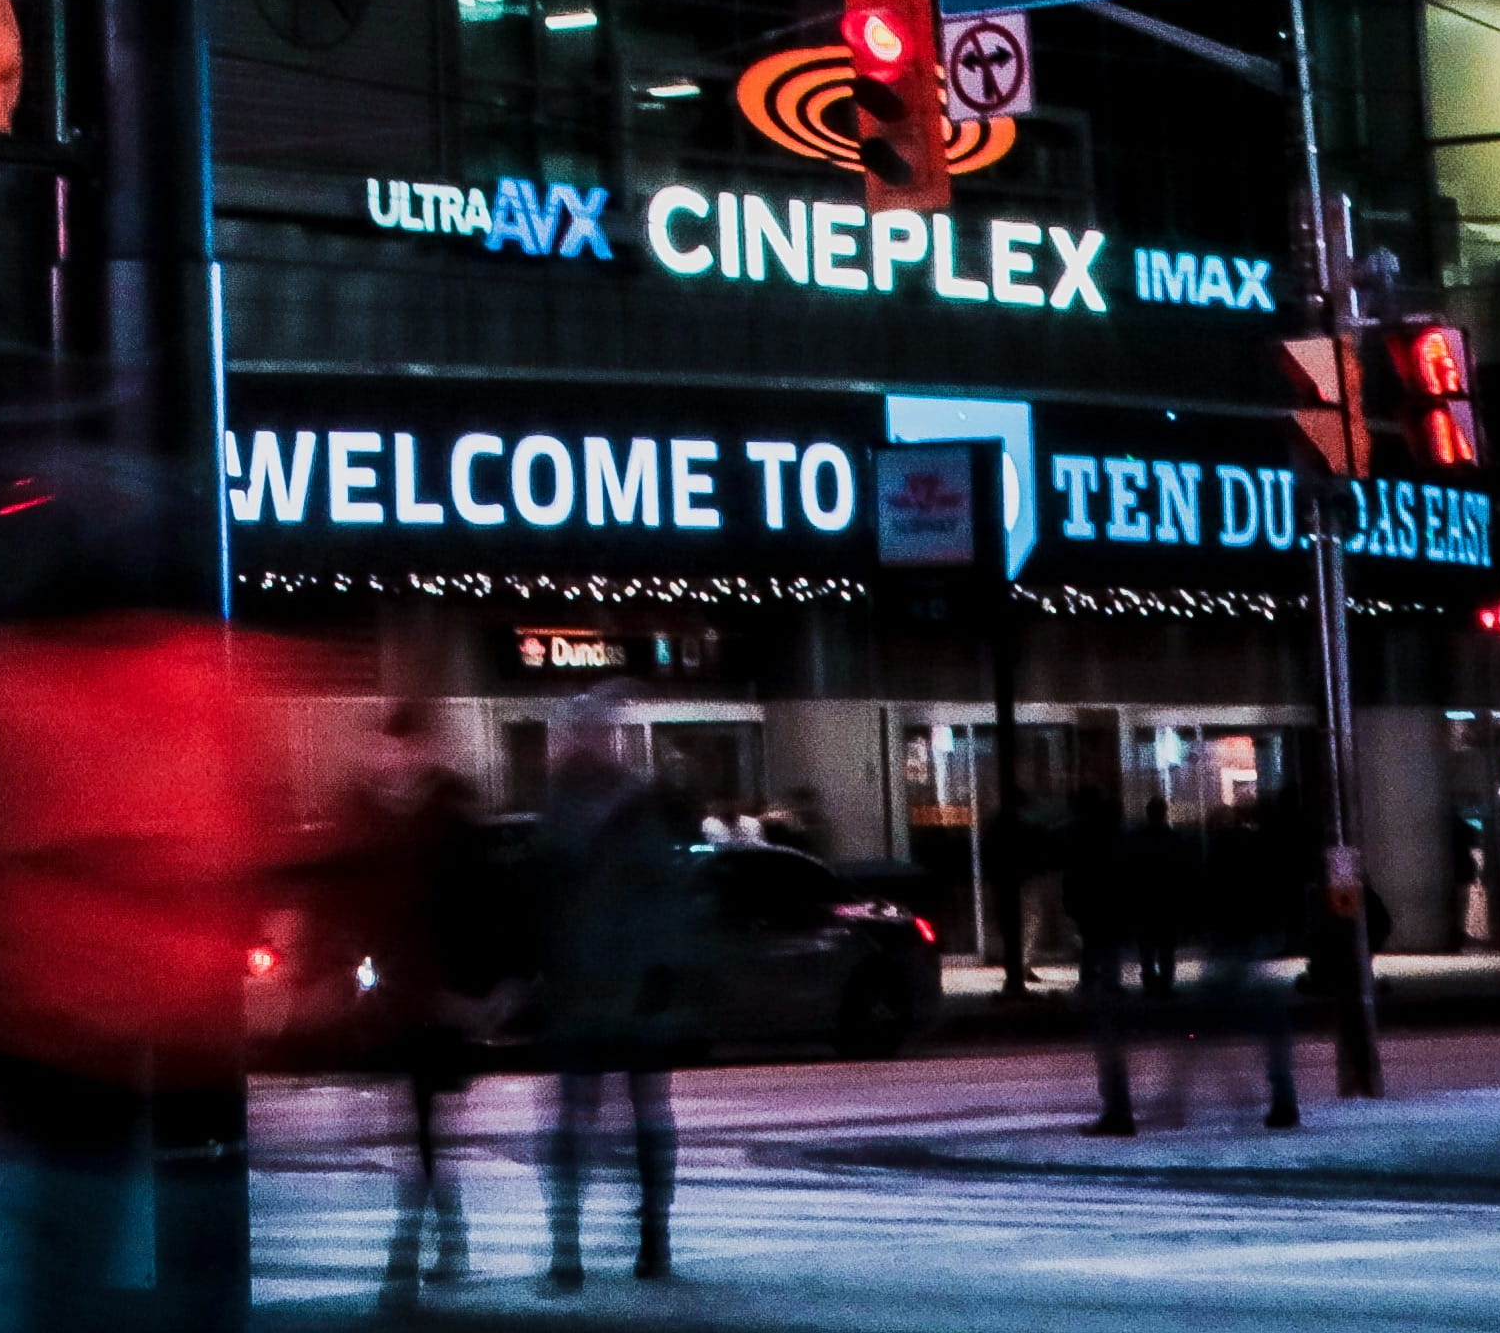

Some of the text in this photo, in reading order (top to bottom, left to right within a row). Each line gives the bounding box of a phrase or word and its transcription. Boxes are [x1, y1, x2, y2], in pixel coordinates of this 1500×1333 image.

[647, 185, 1108, 312] CINEPLEX
[1134, 247, 1277, 312] IMAX
[226, 430, 855, 531] WELCOME TO
[1052, 453, 1200, 545] TEN
[1421, 483, 1491, 568] EAST
